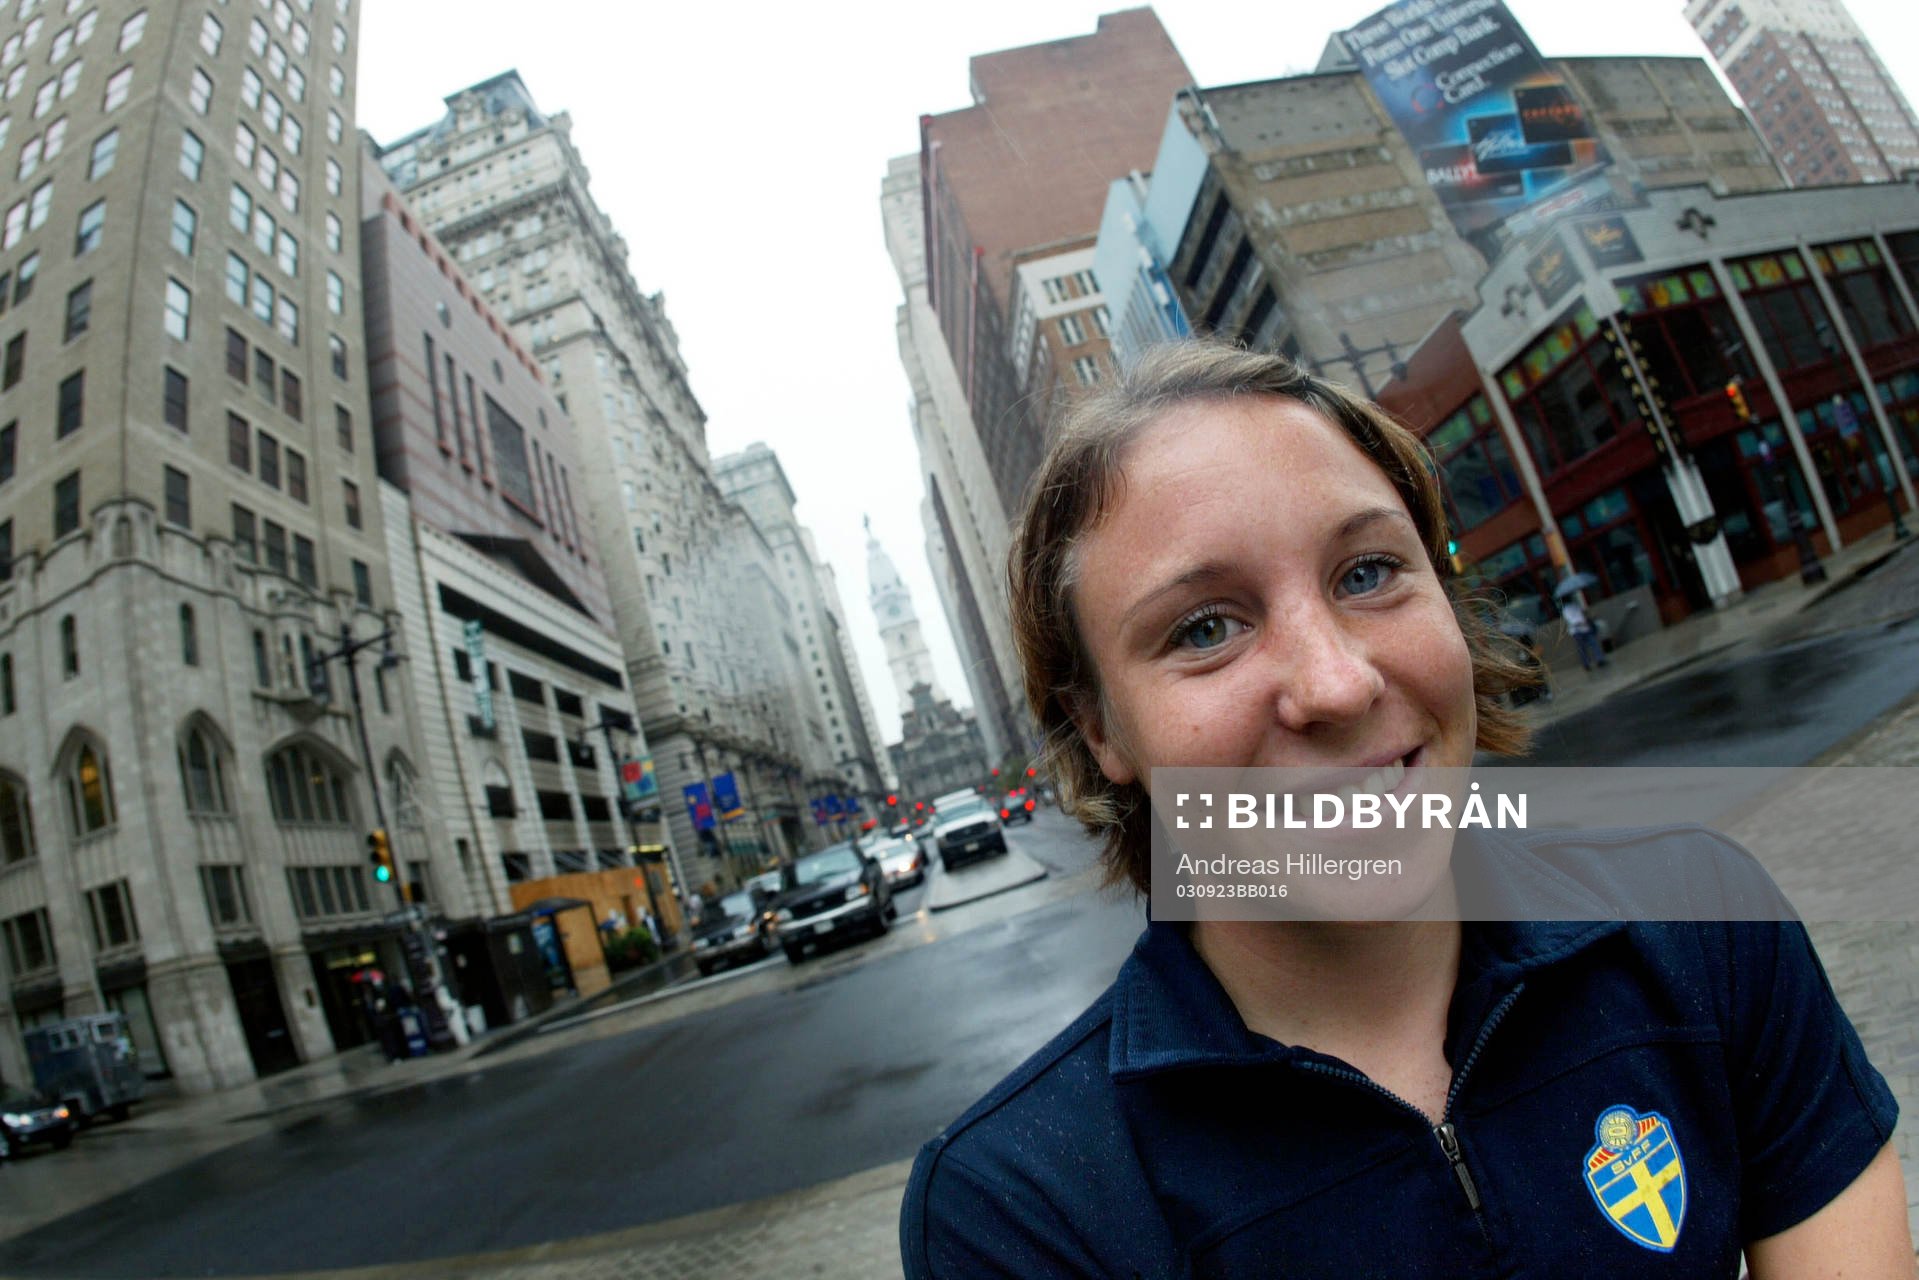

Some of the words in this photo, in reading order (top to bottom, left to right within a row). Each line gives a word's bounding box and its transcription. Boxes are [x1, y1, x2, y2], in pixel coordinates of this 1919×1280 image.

[1344, 20, 1389, 50] Three
[1361, 38, 1405, 68] Form
[1400, 22, 1433, 47] One
[1412, 34, 1461, 65] Comp
[1435, 42, 1524, 90] Connection
